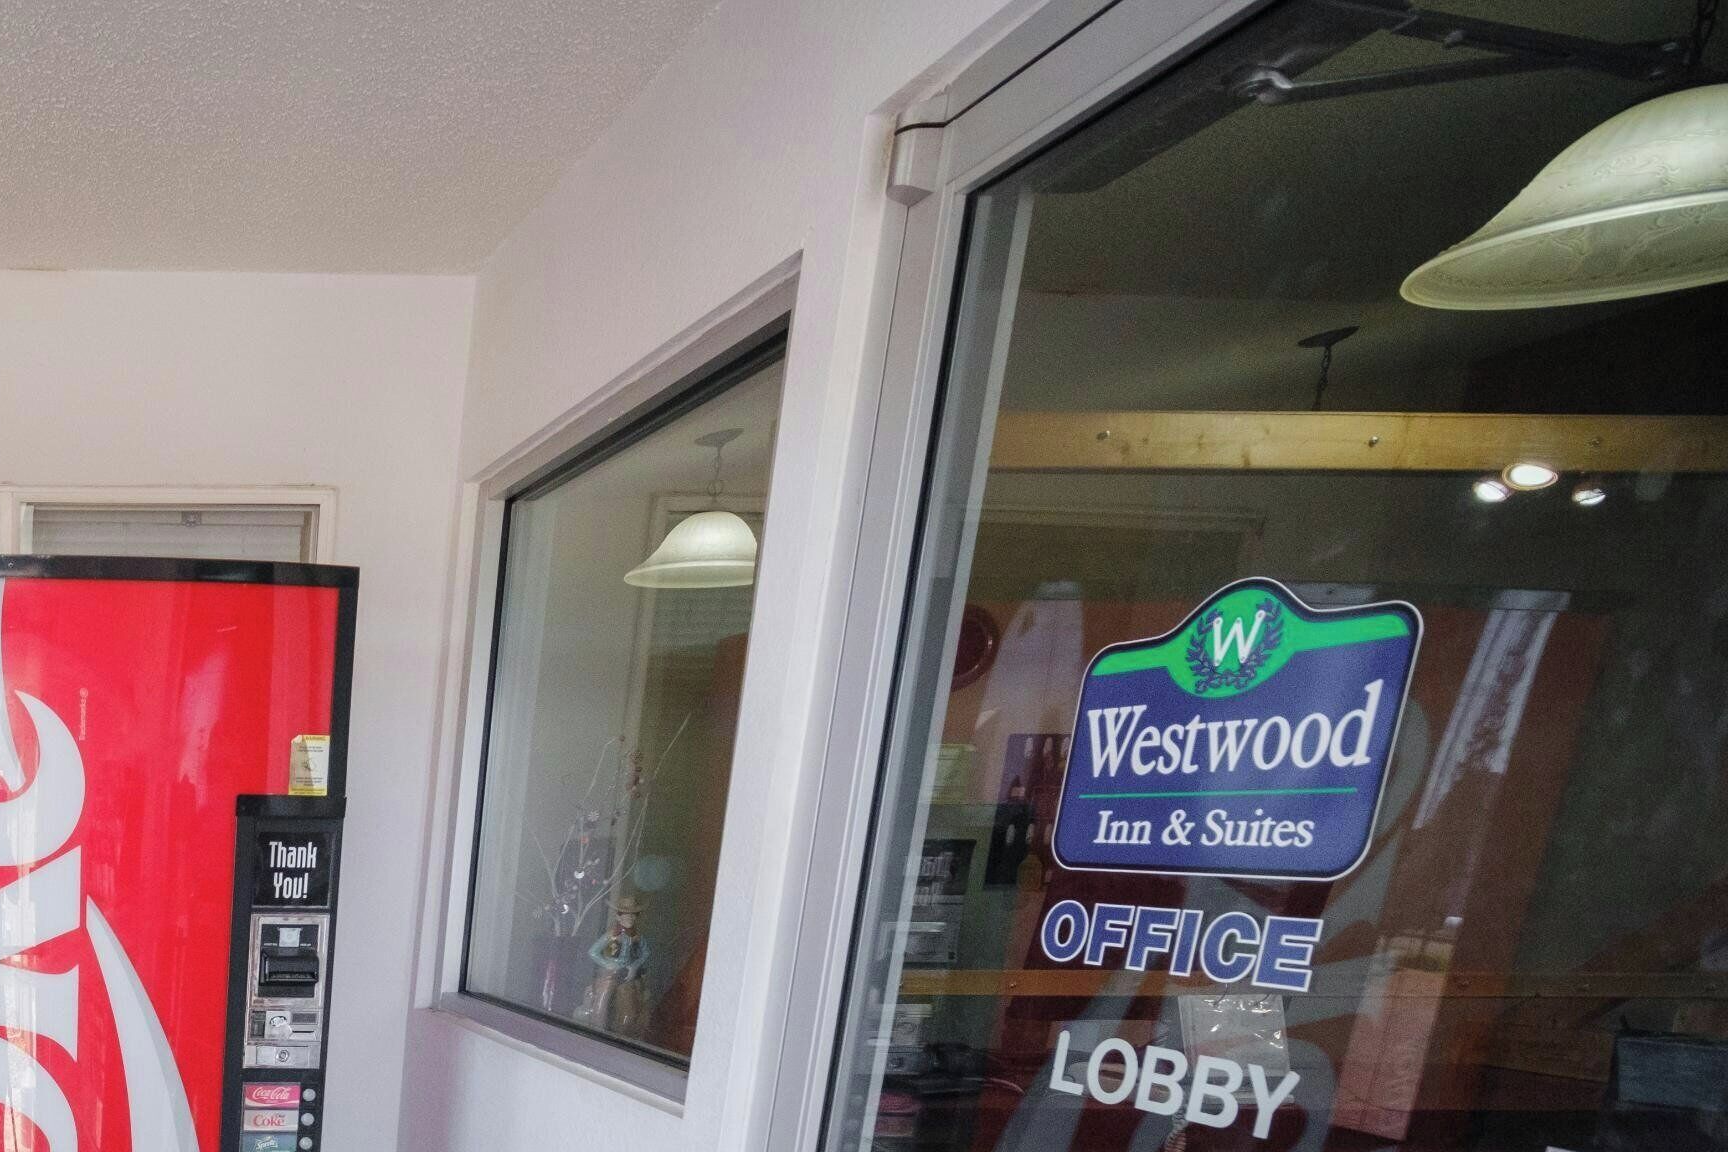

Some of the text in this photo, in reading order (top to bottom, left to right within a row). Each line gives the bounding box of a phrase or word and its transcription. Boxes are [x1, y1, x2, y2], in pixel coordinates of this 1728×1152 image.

[1086, 678, 1386, 779] Westwood
[268, 840, 318, 870] Thank
[1092, 808, 1316, 849] Inn & Suites
[273, 872, 309, 900] You!
[1040, 899, 1324, 993] OFFICE
[1047, 1029, 1301, 1140] LOBBY
